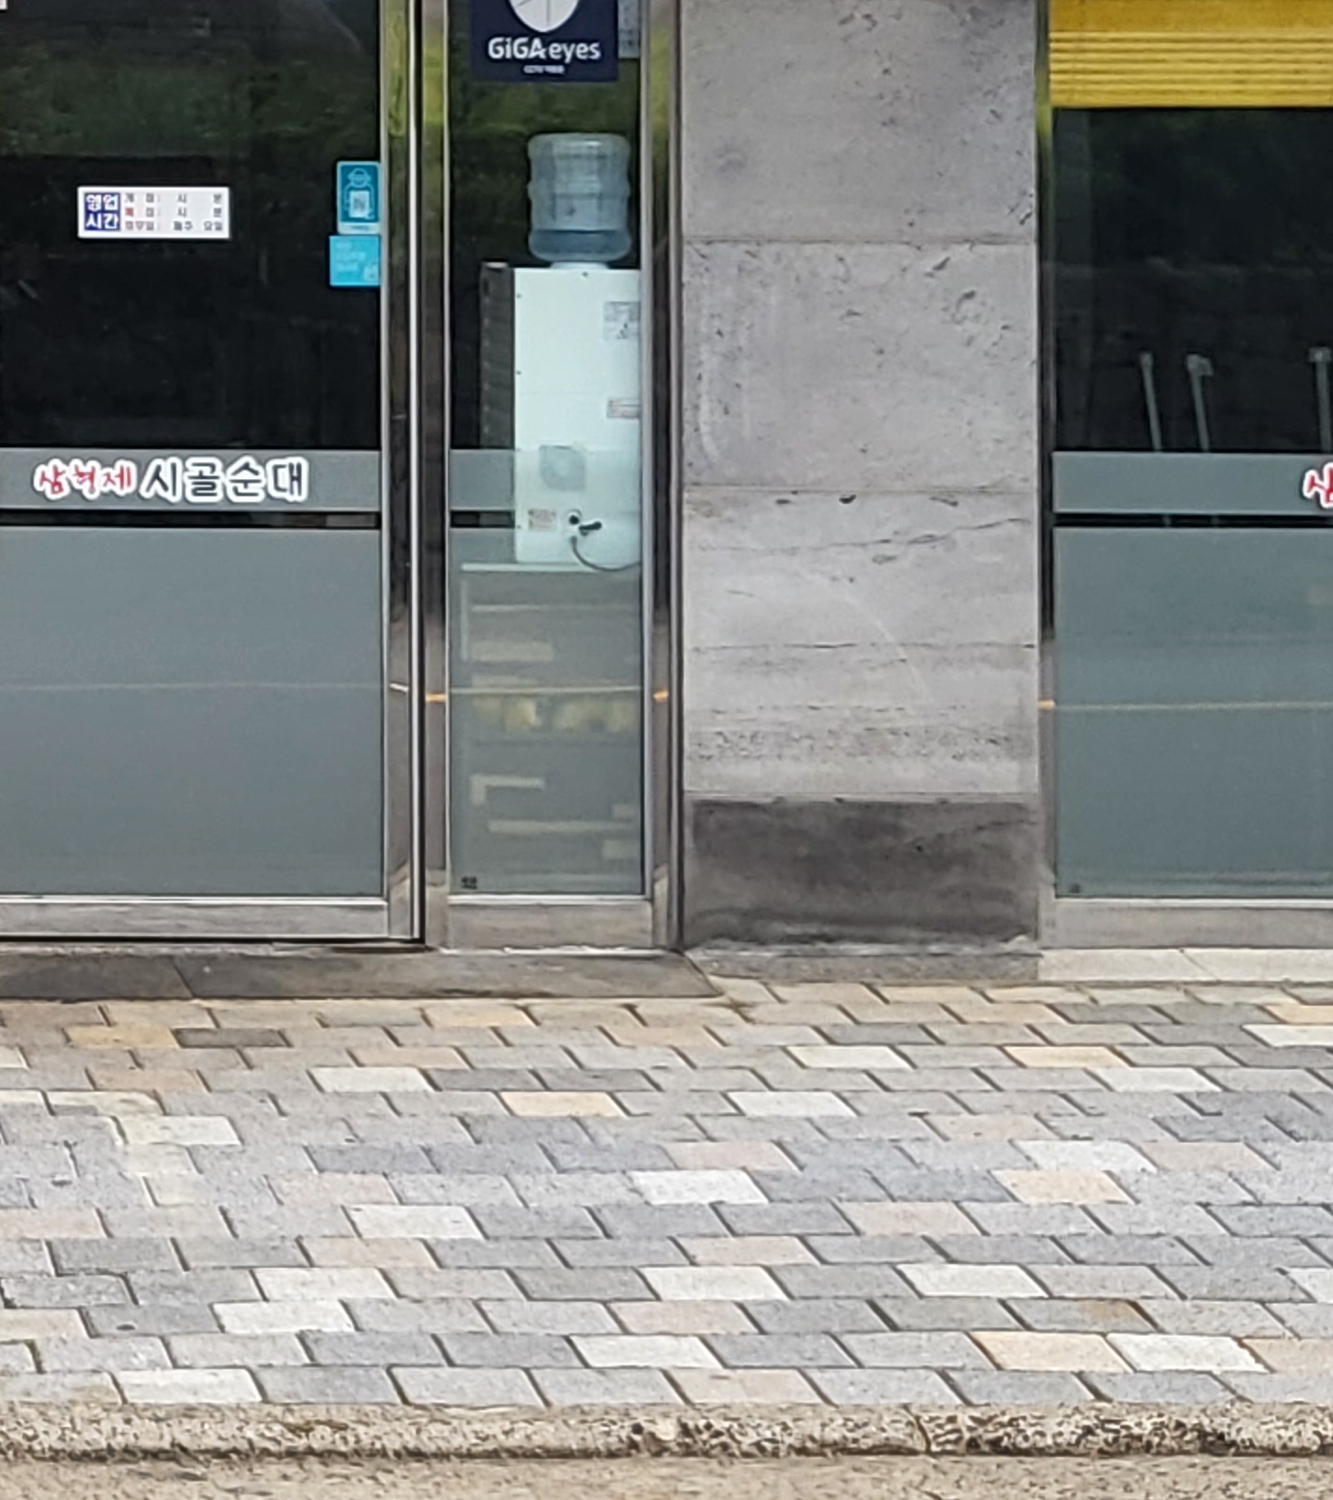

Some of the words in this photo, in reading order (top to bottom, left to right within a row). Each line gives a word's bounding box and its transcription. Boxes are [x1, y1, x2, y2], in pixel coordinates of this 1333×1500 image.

[85, 213, 118, 229] 시간
[33, 458, 136, 500] 삼형제
[139, 456, 309, 502] 시골순대
